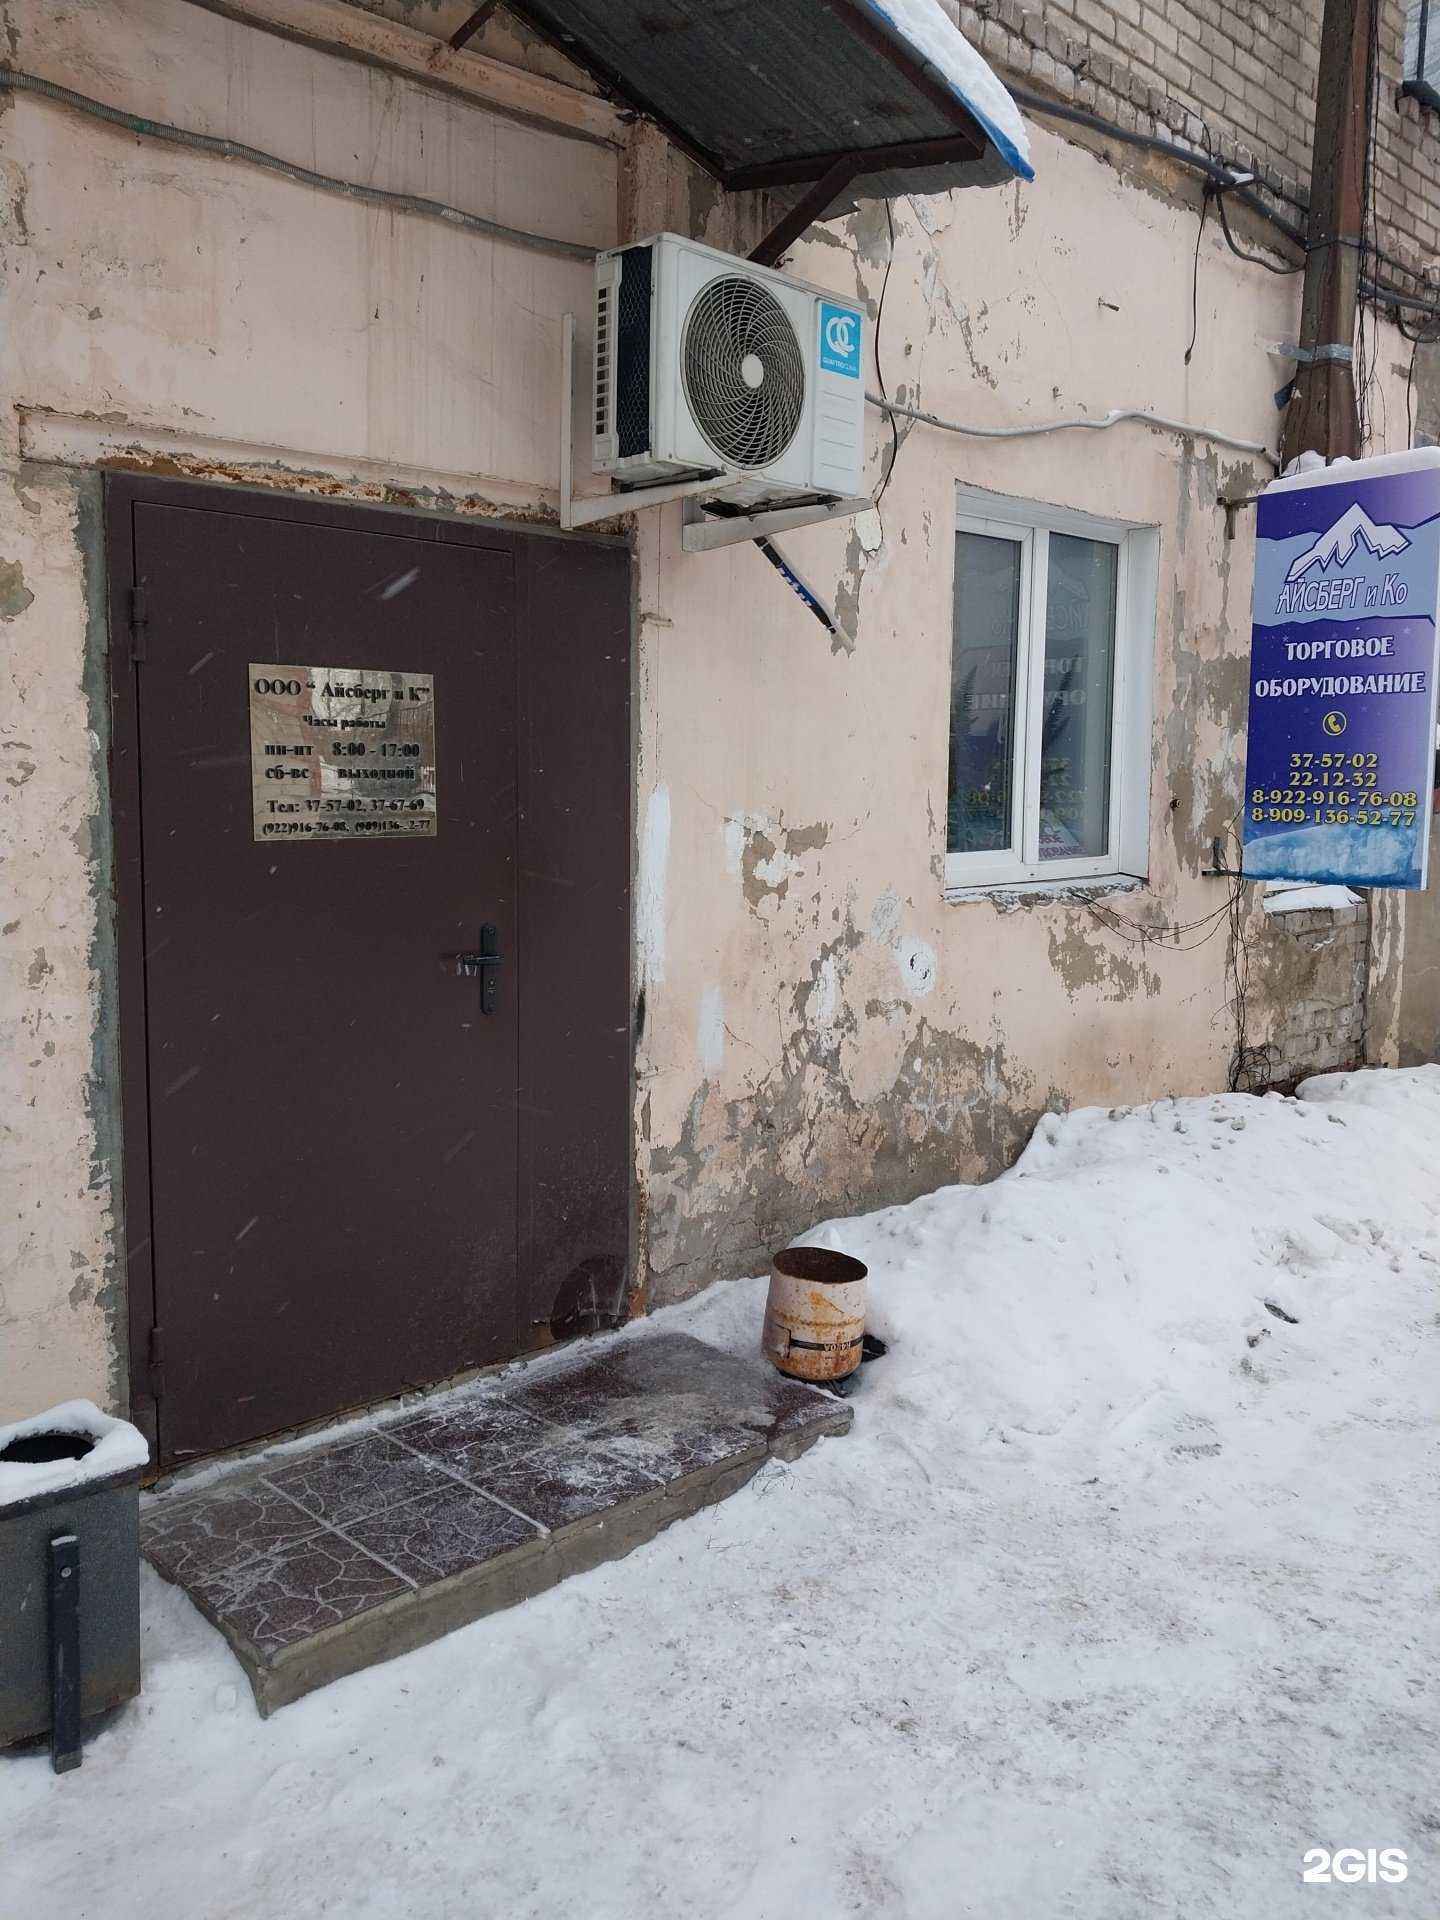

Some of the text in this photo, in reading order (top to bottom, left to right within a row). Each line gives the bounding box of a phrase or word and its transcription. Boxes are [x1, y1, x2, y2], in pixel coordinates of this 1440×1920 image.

[1275, 573, 1408, 614] АЙСБЕРГ и Ко
[1285, 635, 1394, 661] ТОРГОВОЕ
[254, 678, 302, 696] ООО
[1255, 671, 1425, 698] ОБОРУДОВАНИЕ
[303, 714, 386, 730] Часы работы
[264, 744, 314, 756] пн-пт
[332, 742, 365, 757] 8:00
[381, 743, 420, 757] 17:00
[1289, 753, 1378, 768] 37-57-02
[265, 765, 415, 780] сб-вс выходной
[1288, 772, 1377, 787] 22-12-32
[267, 800, 300, 813] Тел:
[1252, 789, 1418, 807] 8-922-916-76-08
[1251, 808, 1416, 826] 8-909-136-52-77
